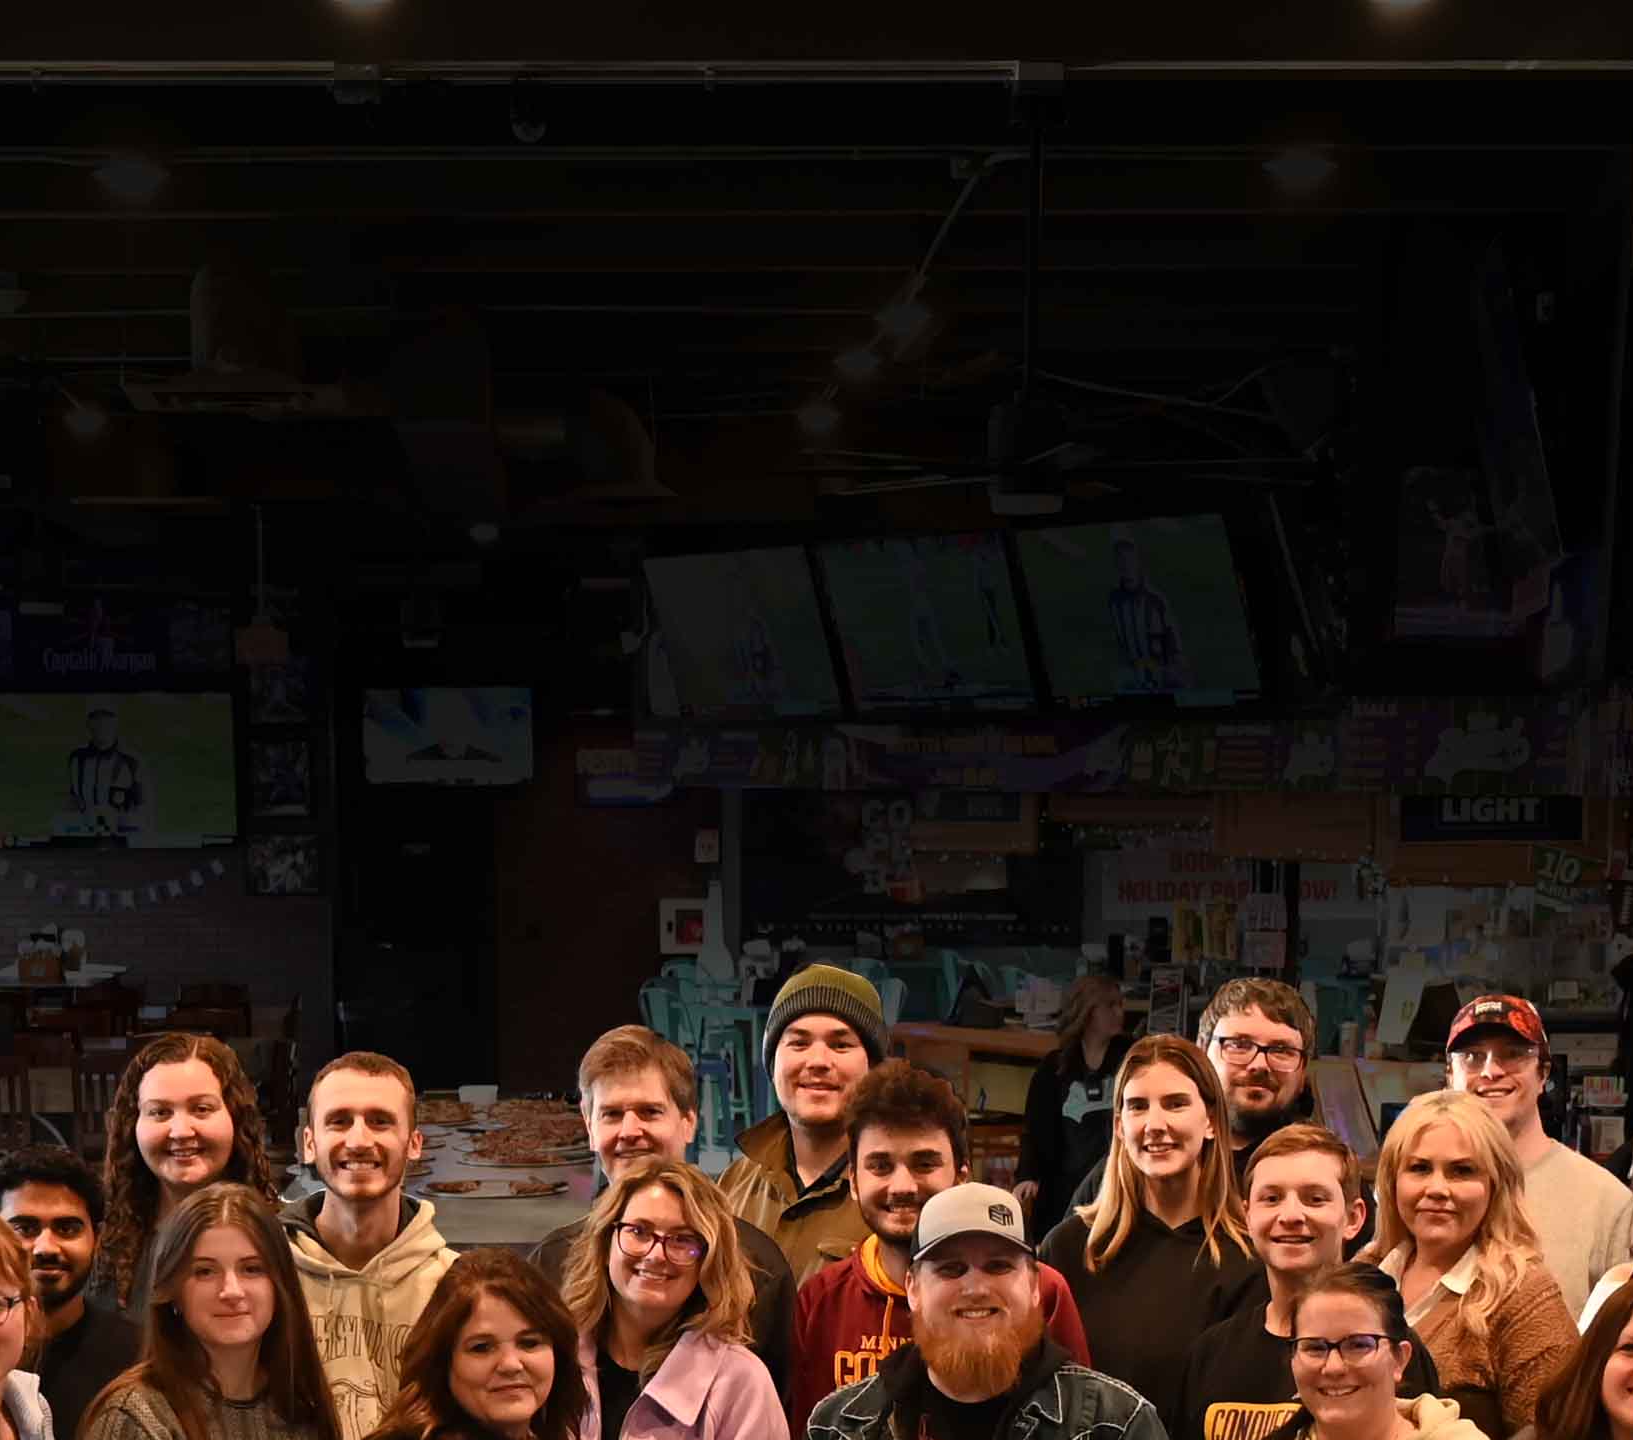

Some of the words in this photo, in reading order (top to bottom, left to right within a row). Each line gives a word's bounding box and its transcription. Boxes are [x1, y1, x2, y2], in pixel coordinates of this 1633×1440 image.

[42, 647, 96, 679] Captain
[98, 645, 158, 674] Morgan
[1441, 796, 1544, 823] LIGHT
[1536, 848, 1583, 883] 10
[1117, 880, 1208, 904] HOLIDAY
